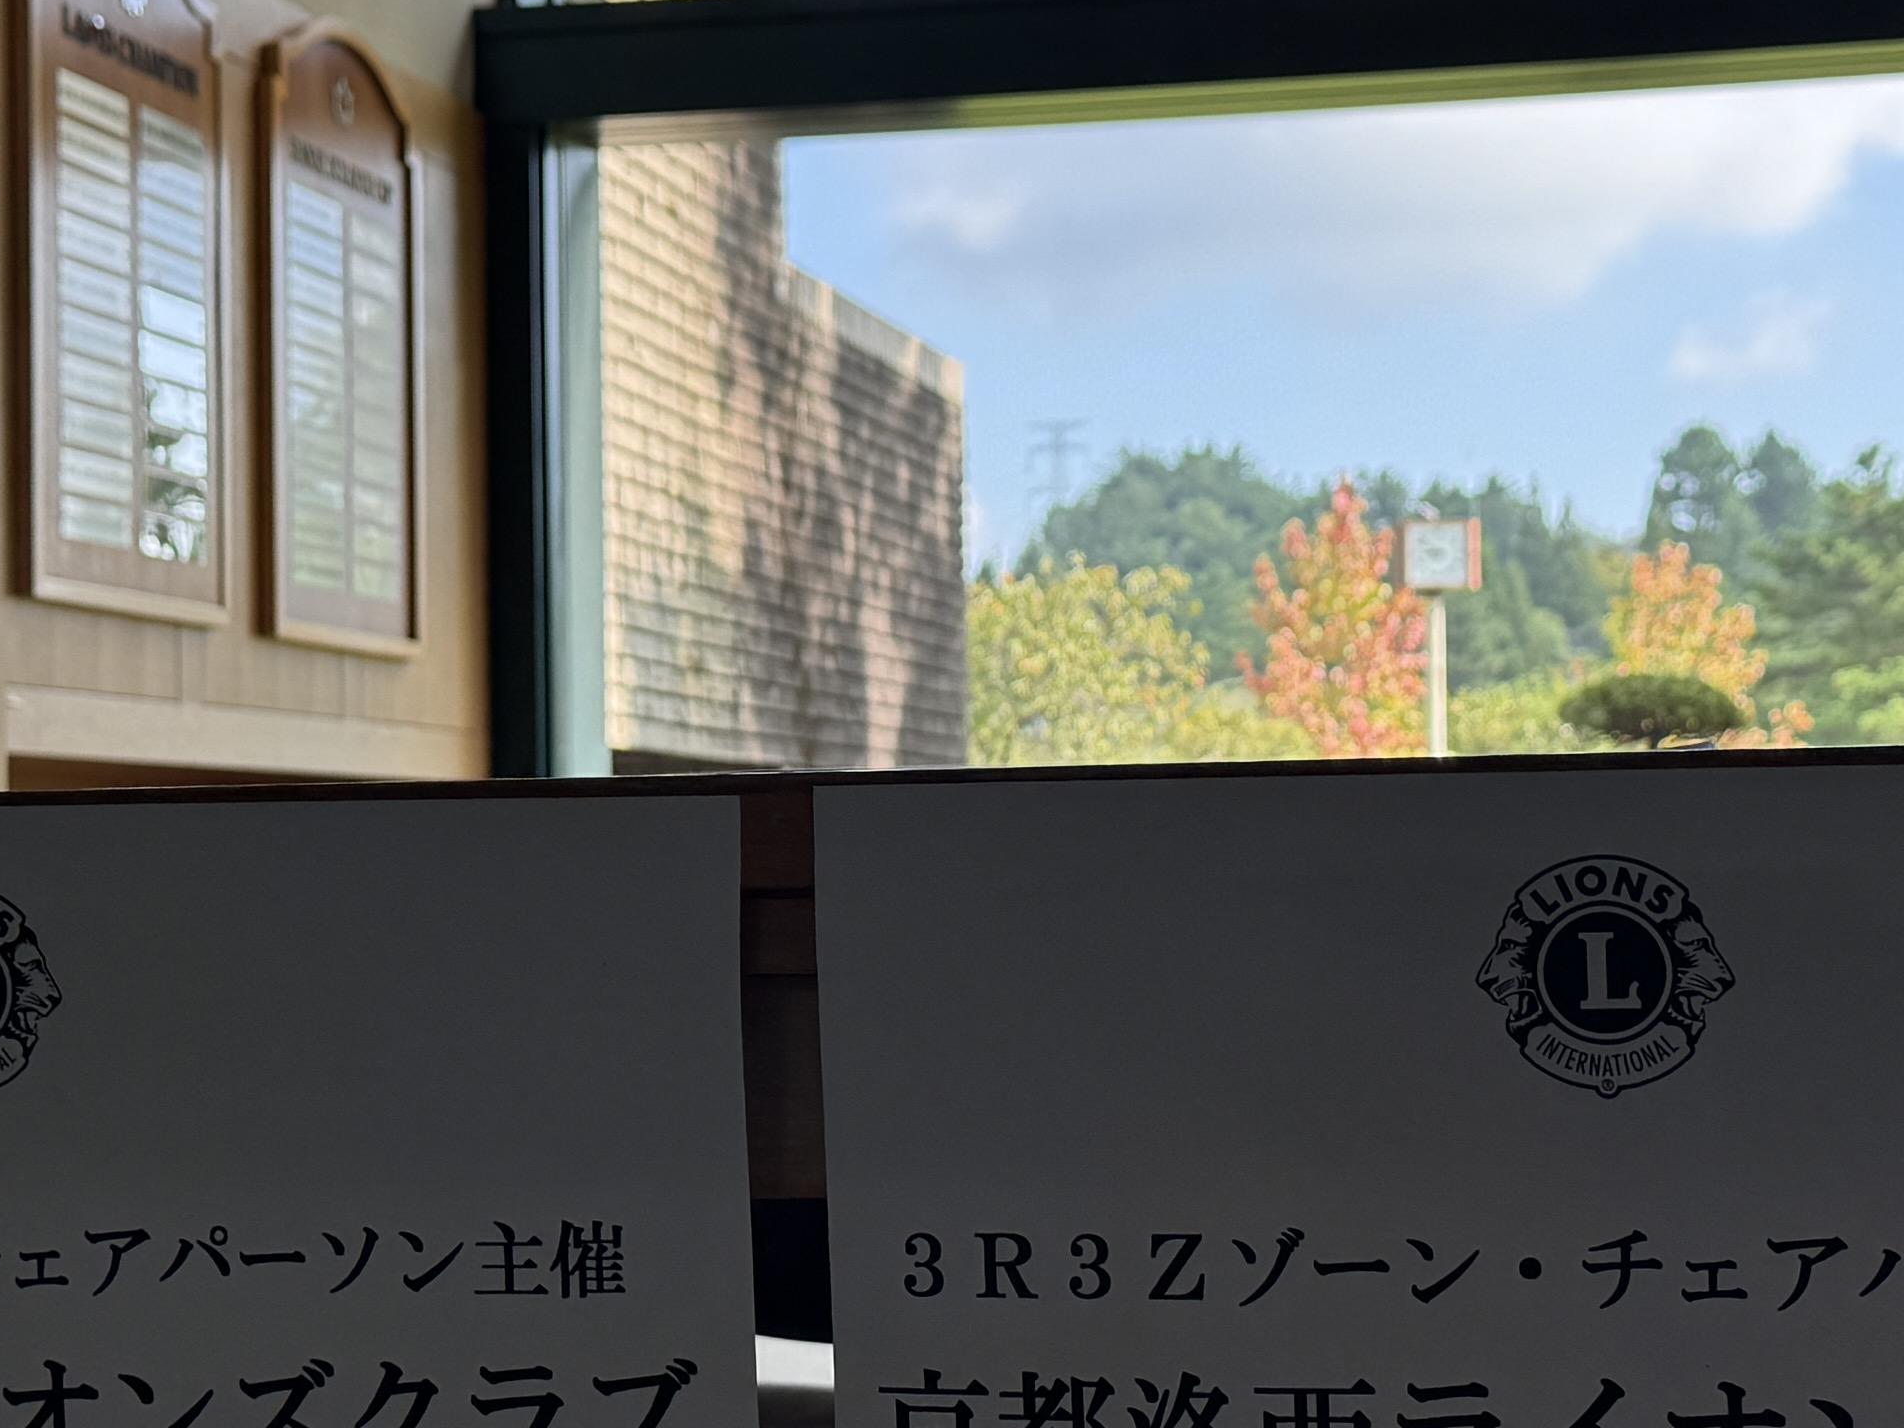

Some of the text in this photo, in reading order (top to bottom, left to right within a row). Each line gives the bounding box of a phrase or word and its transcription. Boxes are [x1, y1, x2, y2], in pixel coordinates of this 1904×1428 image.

[1529, 865, 1675, 916] LIONS
[1578, 932, 1642, 1009] L
[1536, 1034, 1679, 1077] INTERNATIONAL
